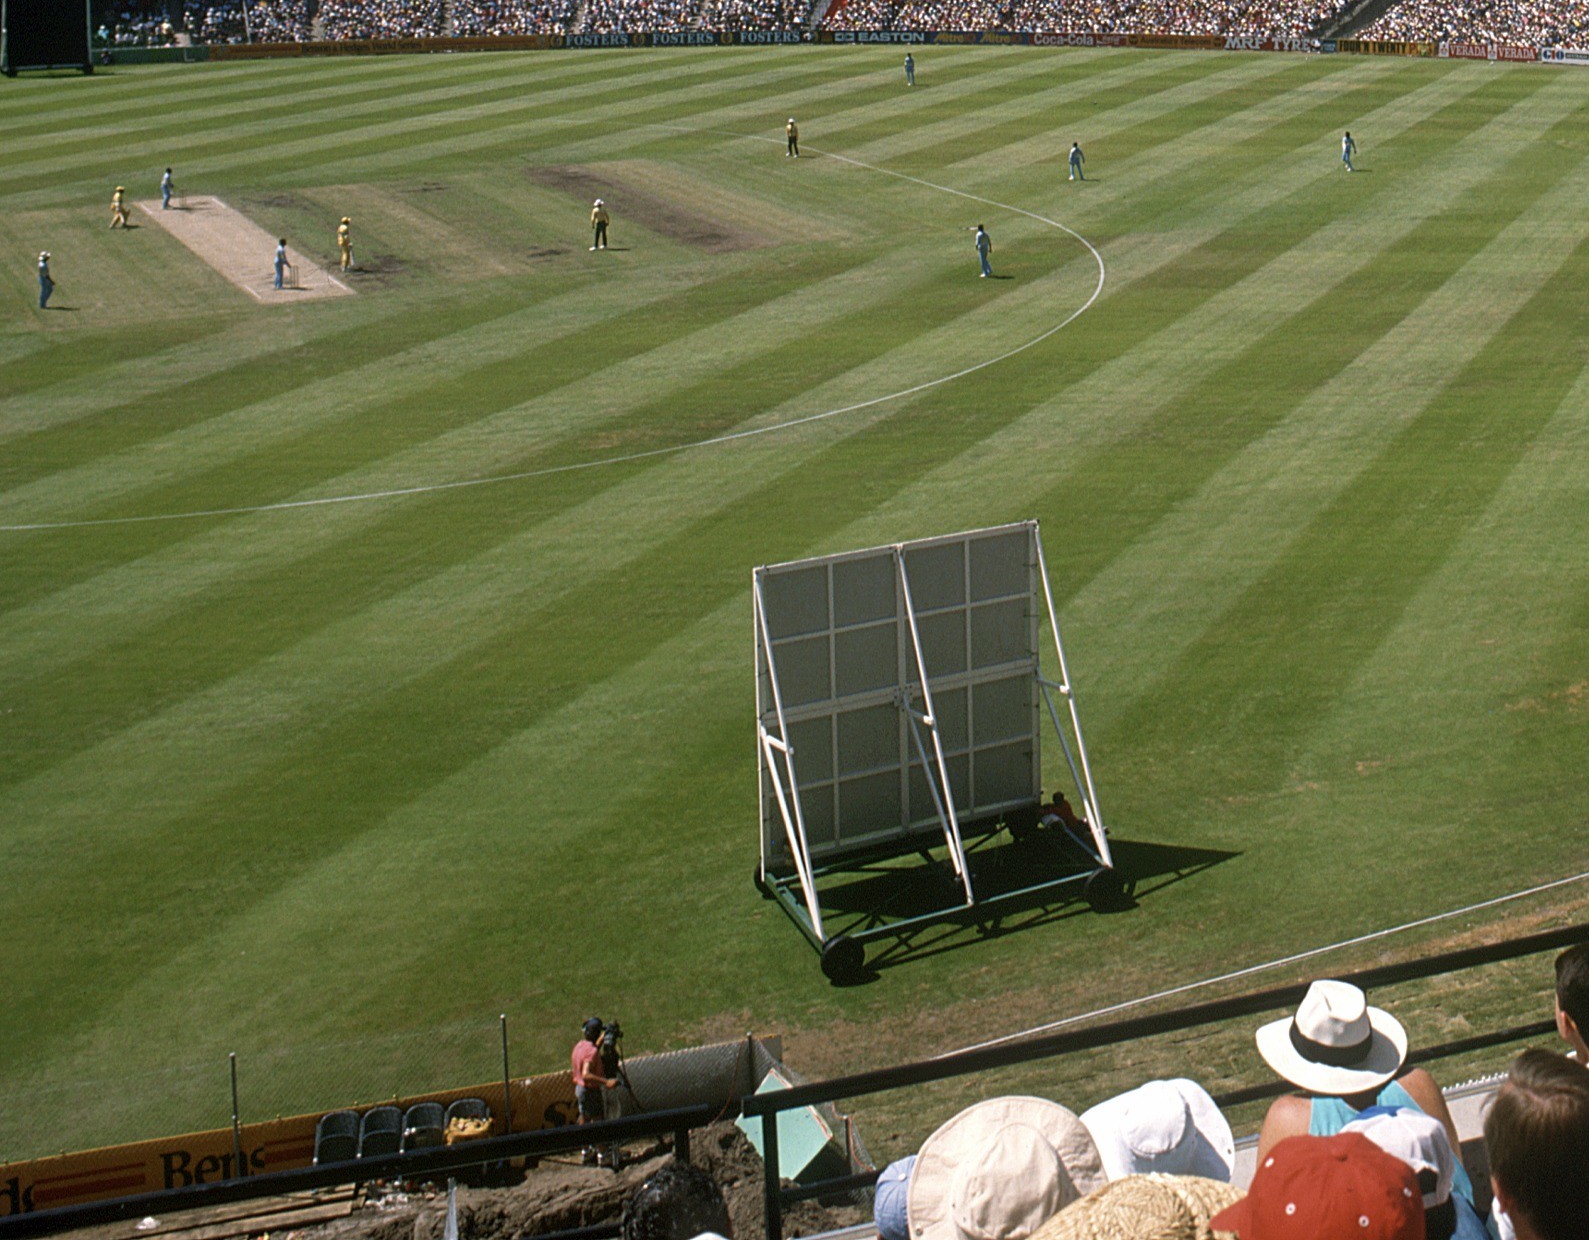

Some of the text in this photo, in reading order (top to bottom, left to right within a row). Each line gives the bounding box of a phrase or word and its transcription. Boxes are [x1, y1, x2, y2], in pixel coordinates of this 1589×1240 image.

[858, 32, 925, 42] EASTON
[1033, 33, 1094, 46] Coca-Cola
[1224, 36, 1267, 50] MRF
[1450, 44, 1486, 58] VERADA
[1498, 46, 1536, 60] VERADA
